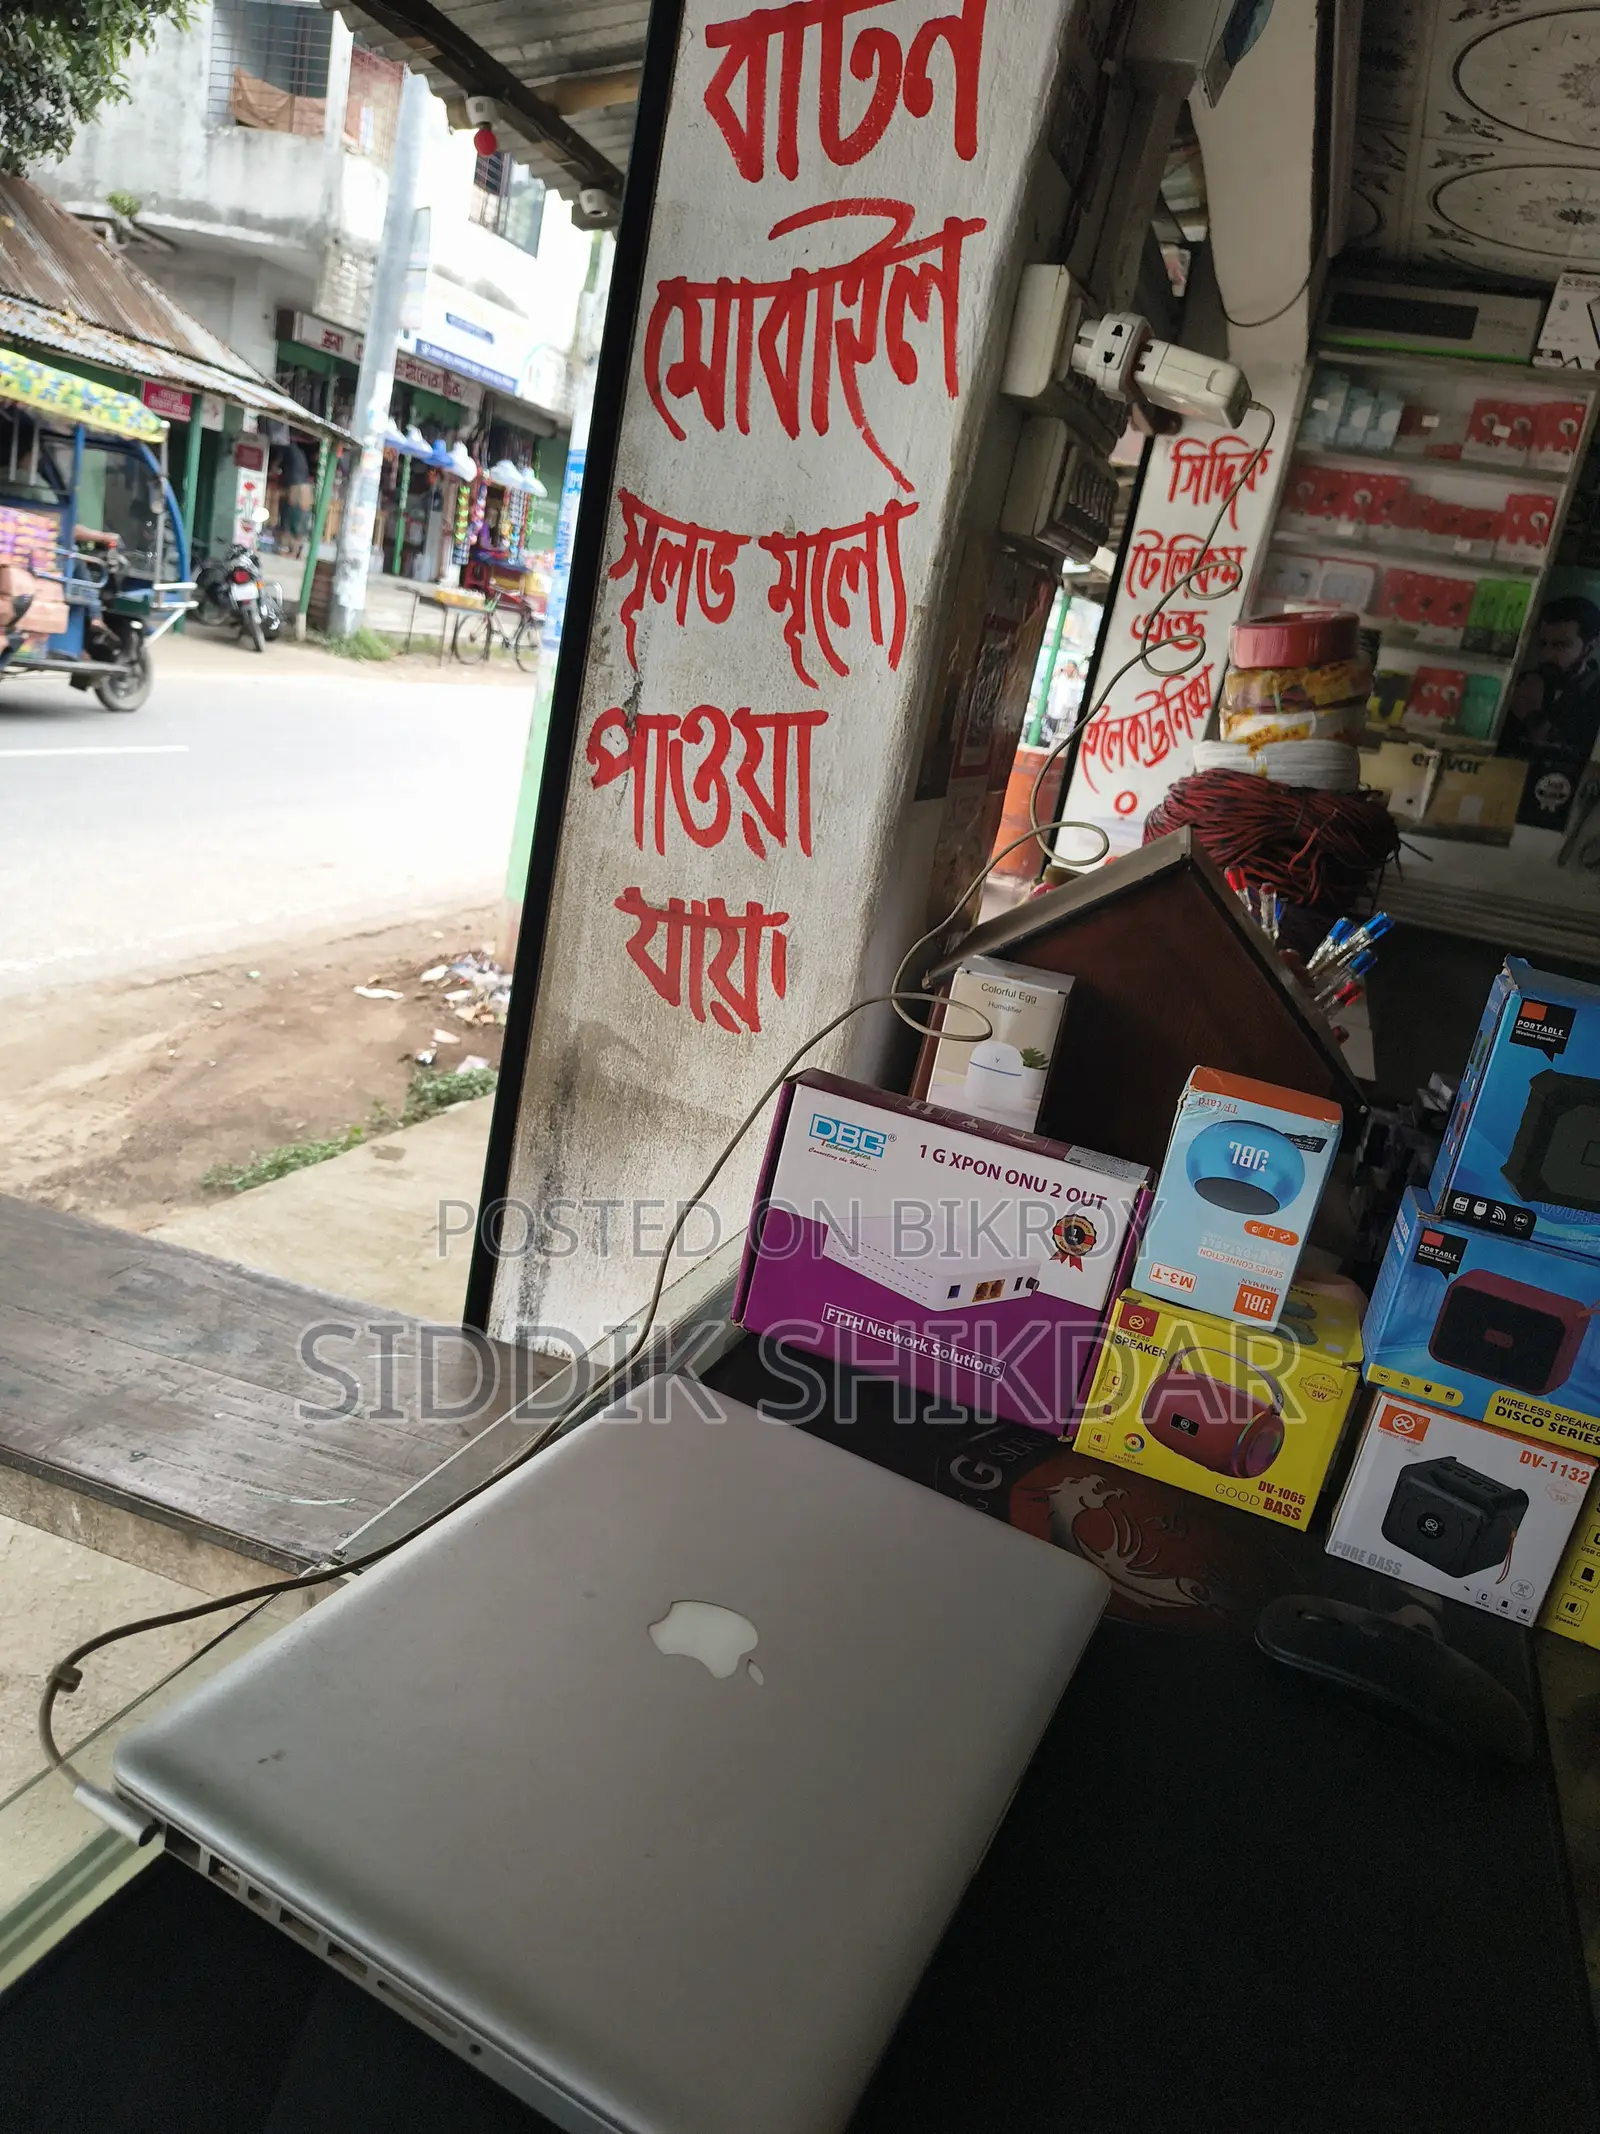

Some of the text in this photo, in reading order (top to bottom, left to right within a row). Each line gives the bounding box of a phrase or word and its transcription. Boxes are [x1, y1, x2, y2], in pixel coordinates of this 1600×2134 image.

[644, 198, 987, 492] মোবাইল
[587, 705, 829, 860] পাওয়া
[981, 982, 1038, 1005] Colorful Egg
[988, 1001, 1022, 1014] Humidifier
[1517, 1019, 1564, 1037] PORTABLE
[1198, 1096, 1221, 1109] card
[821, 1139, 872, 1160] Technologies
[1229, 1141, 1270, 1172] JBL
[920, 1144, 1107, 1211] 1 G XPON ONU 2 OUT
[1200, 1248, 1284, 1278] SERIES CONNECTION
[1419, 1244, 1457, 1260] PORTABLE
[1152, 1266, 1194, 1289] M3-T
[1242, 1291, 1272, 1315] JBL
[826, 1307, 1001, 1377] FTTH Network Solutions
[1114, 1335, 1168, 1359] SPEAKER
[1117, 1328, 1151, 1342] WIRELESS
[1311, 1389, 1328, 1400] 5W
[1495, 1406, 1545, 1428] DISCO
[1497, 1396, 1551, 1419] WIRELESS
[1519, 1449, 1590, 1485] DV-1132
[1215, 1483, 1302, 1521] GOOD BASS
[1258, 1480, 1307, 1505] DV-1065
[1333, 1540, 1403, 1576] PURE BASS
